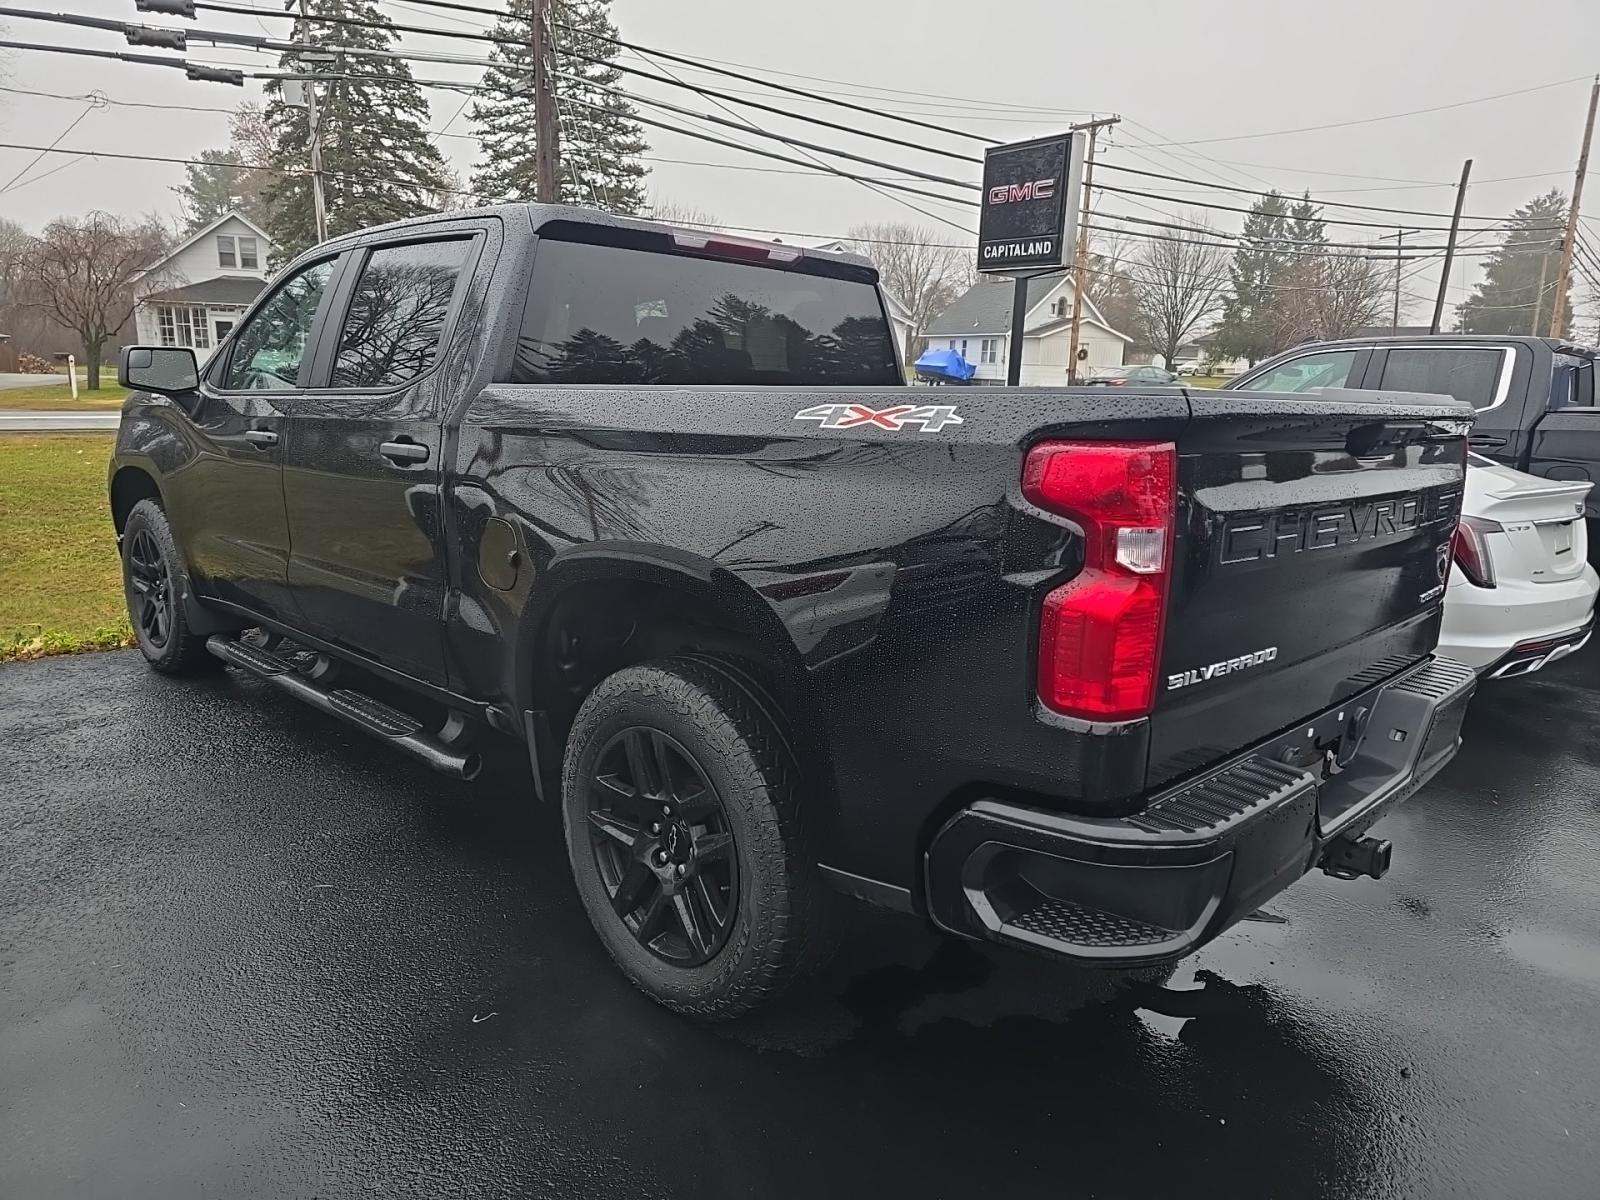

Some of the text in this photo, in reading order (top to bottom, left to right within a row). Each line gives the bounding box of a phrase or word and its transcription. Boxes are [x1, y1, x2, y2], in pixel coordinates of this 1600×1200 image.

[988, 178, 1057, 205] GMC
[983, 241, 1052, 259] CAPITALAND
[1167, 646, 1278, 690] SILVERADO
